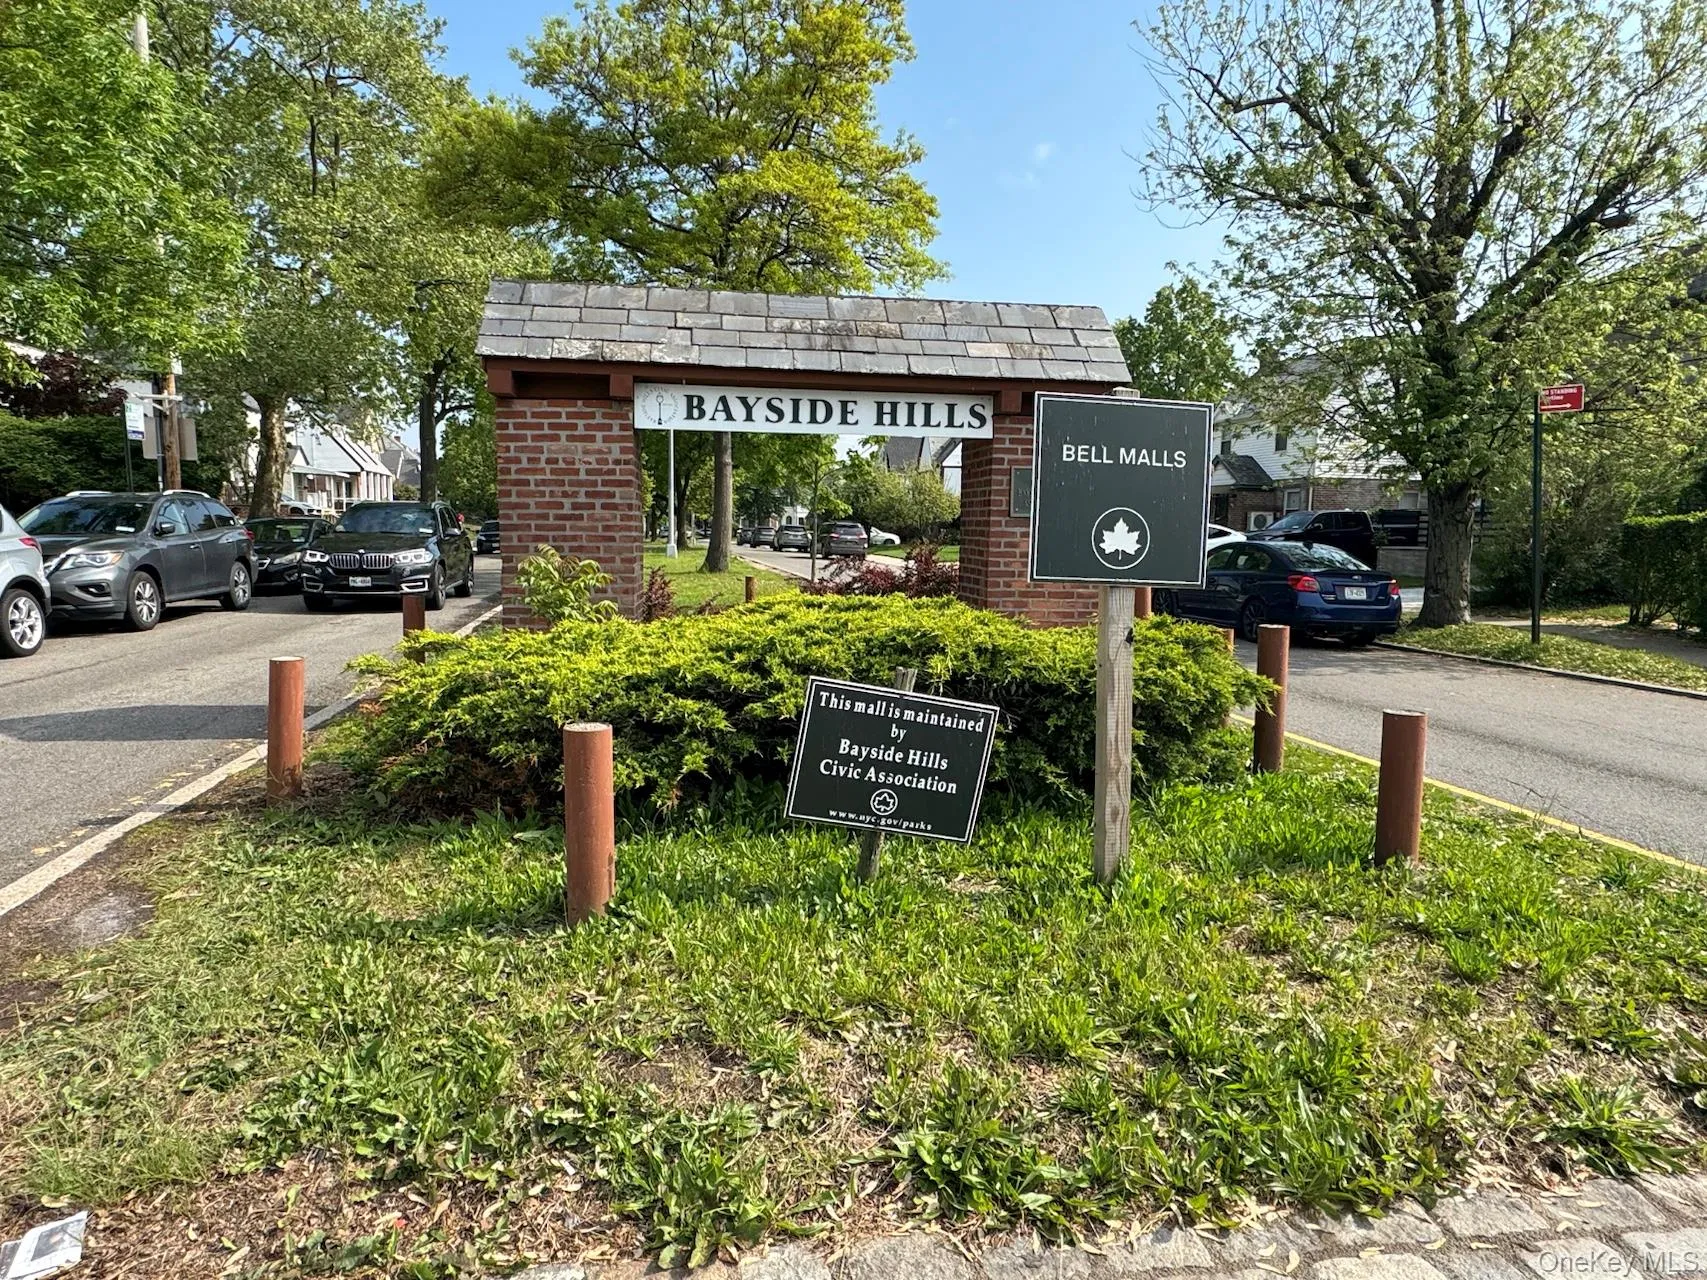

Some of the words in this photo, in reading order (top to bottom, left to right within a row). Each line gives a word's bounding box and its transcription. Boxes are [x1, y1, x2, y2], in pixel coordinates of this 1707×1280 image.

[683, 394, 859, 426] BAYSIDE
[873, 400, 987, 429] HILLS
[1062, 444, 1114, 463] BELL
[1119, 447, 1187, 468] MALLS
[819, 691, 851, 711] This
[854, 700, 886, 717] mall
[888, 702, 900, 719] is
[903, 710, 985, 733] maintained
[890, 723, 907, 743] by
[838, 738, 904, 763] Bayside
[907, 749, 949, 771] Hills
[819, 758, 862, 780] Civic
[864, 766, 957, 794] Association
[829, 809, 933, 831] www.nyc.gov/parks
